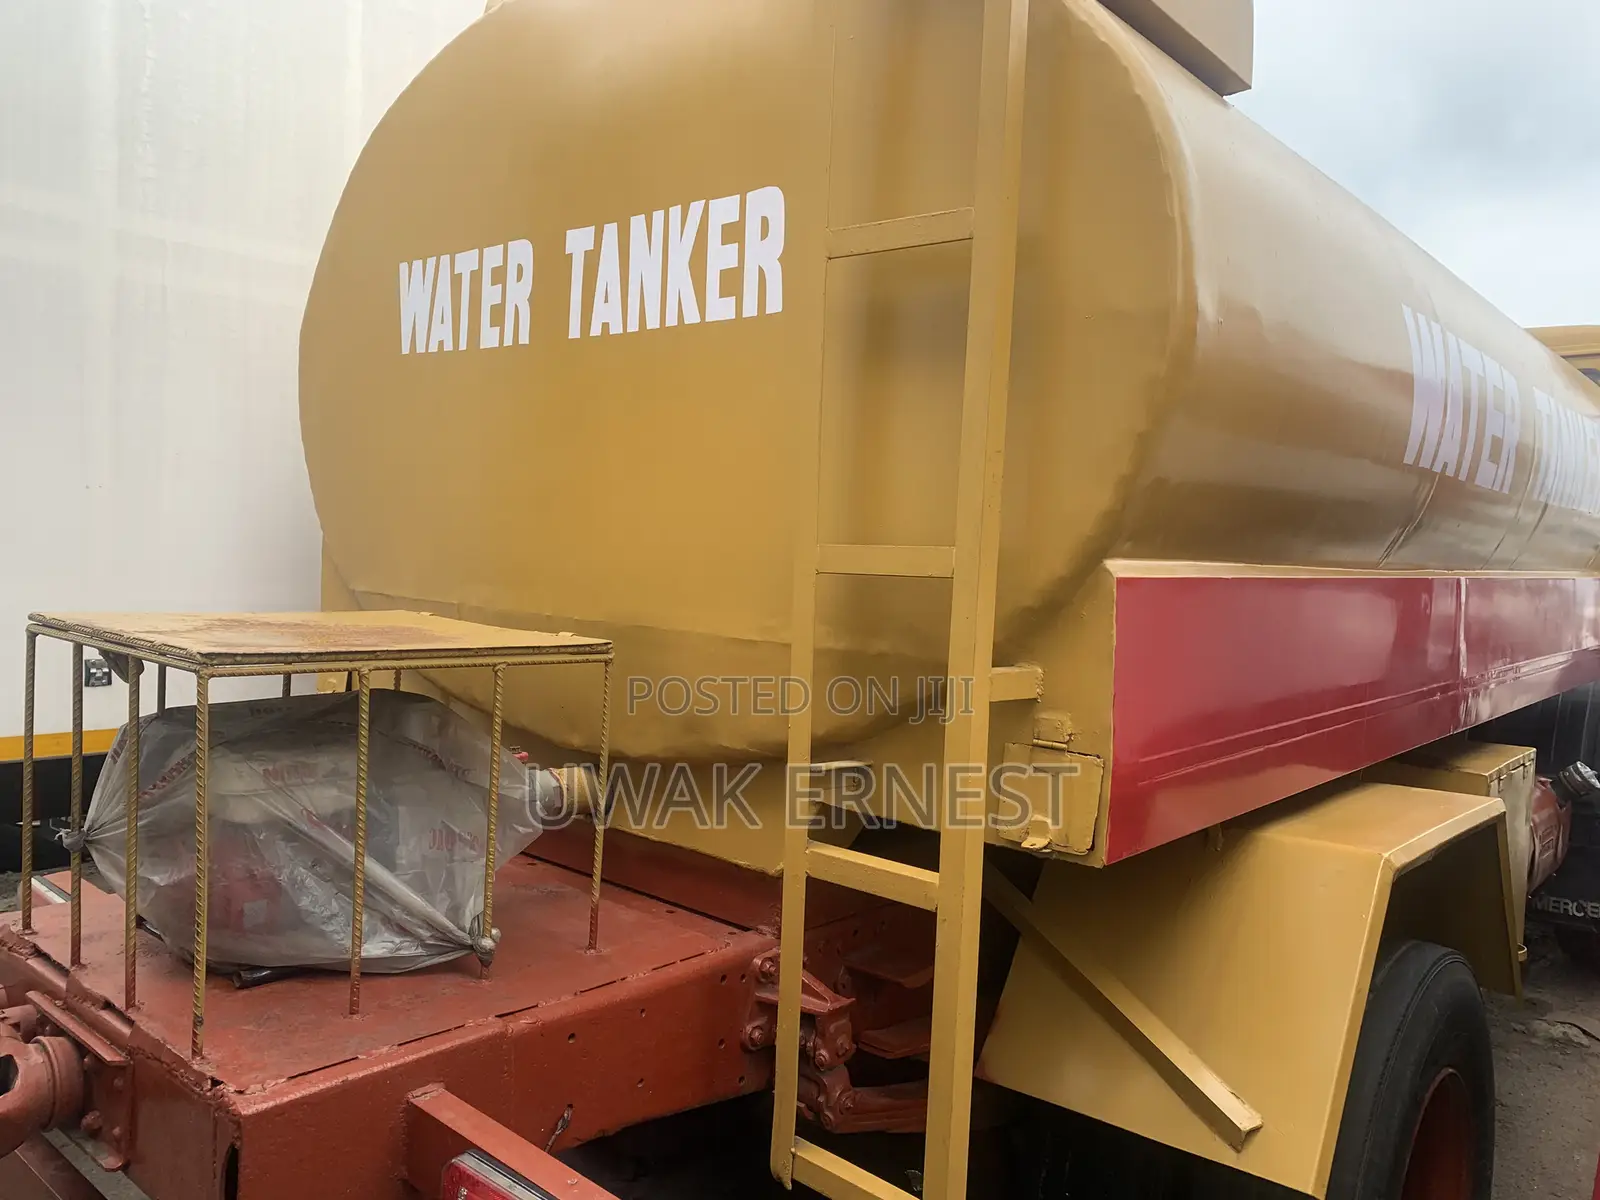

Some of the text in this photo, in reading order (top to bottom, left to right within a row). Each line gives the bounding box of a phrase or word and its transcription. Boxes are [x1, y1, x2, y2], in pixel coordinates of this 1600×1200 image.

[399, 186, 785, 355] WATER TANKER
[1403, 305, 1519, 494] WATER
